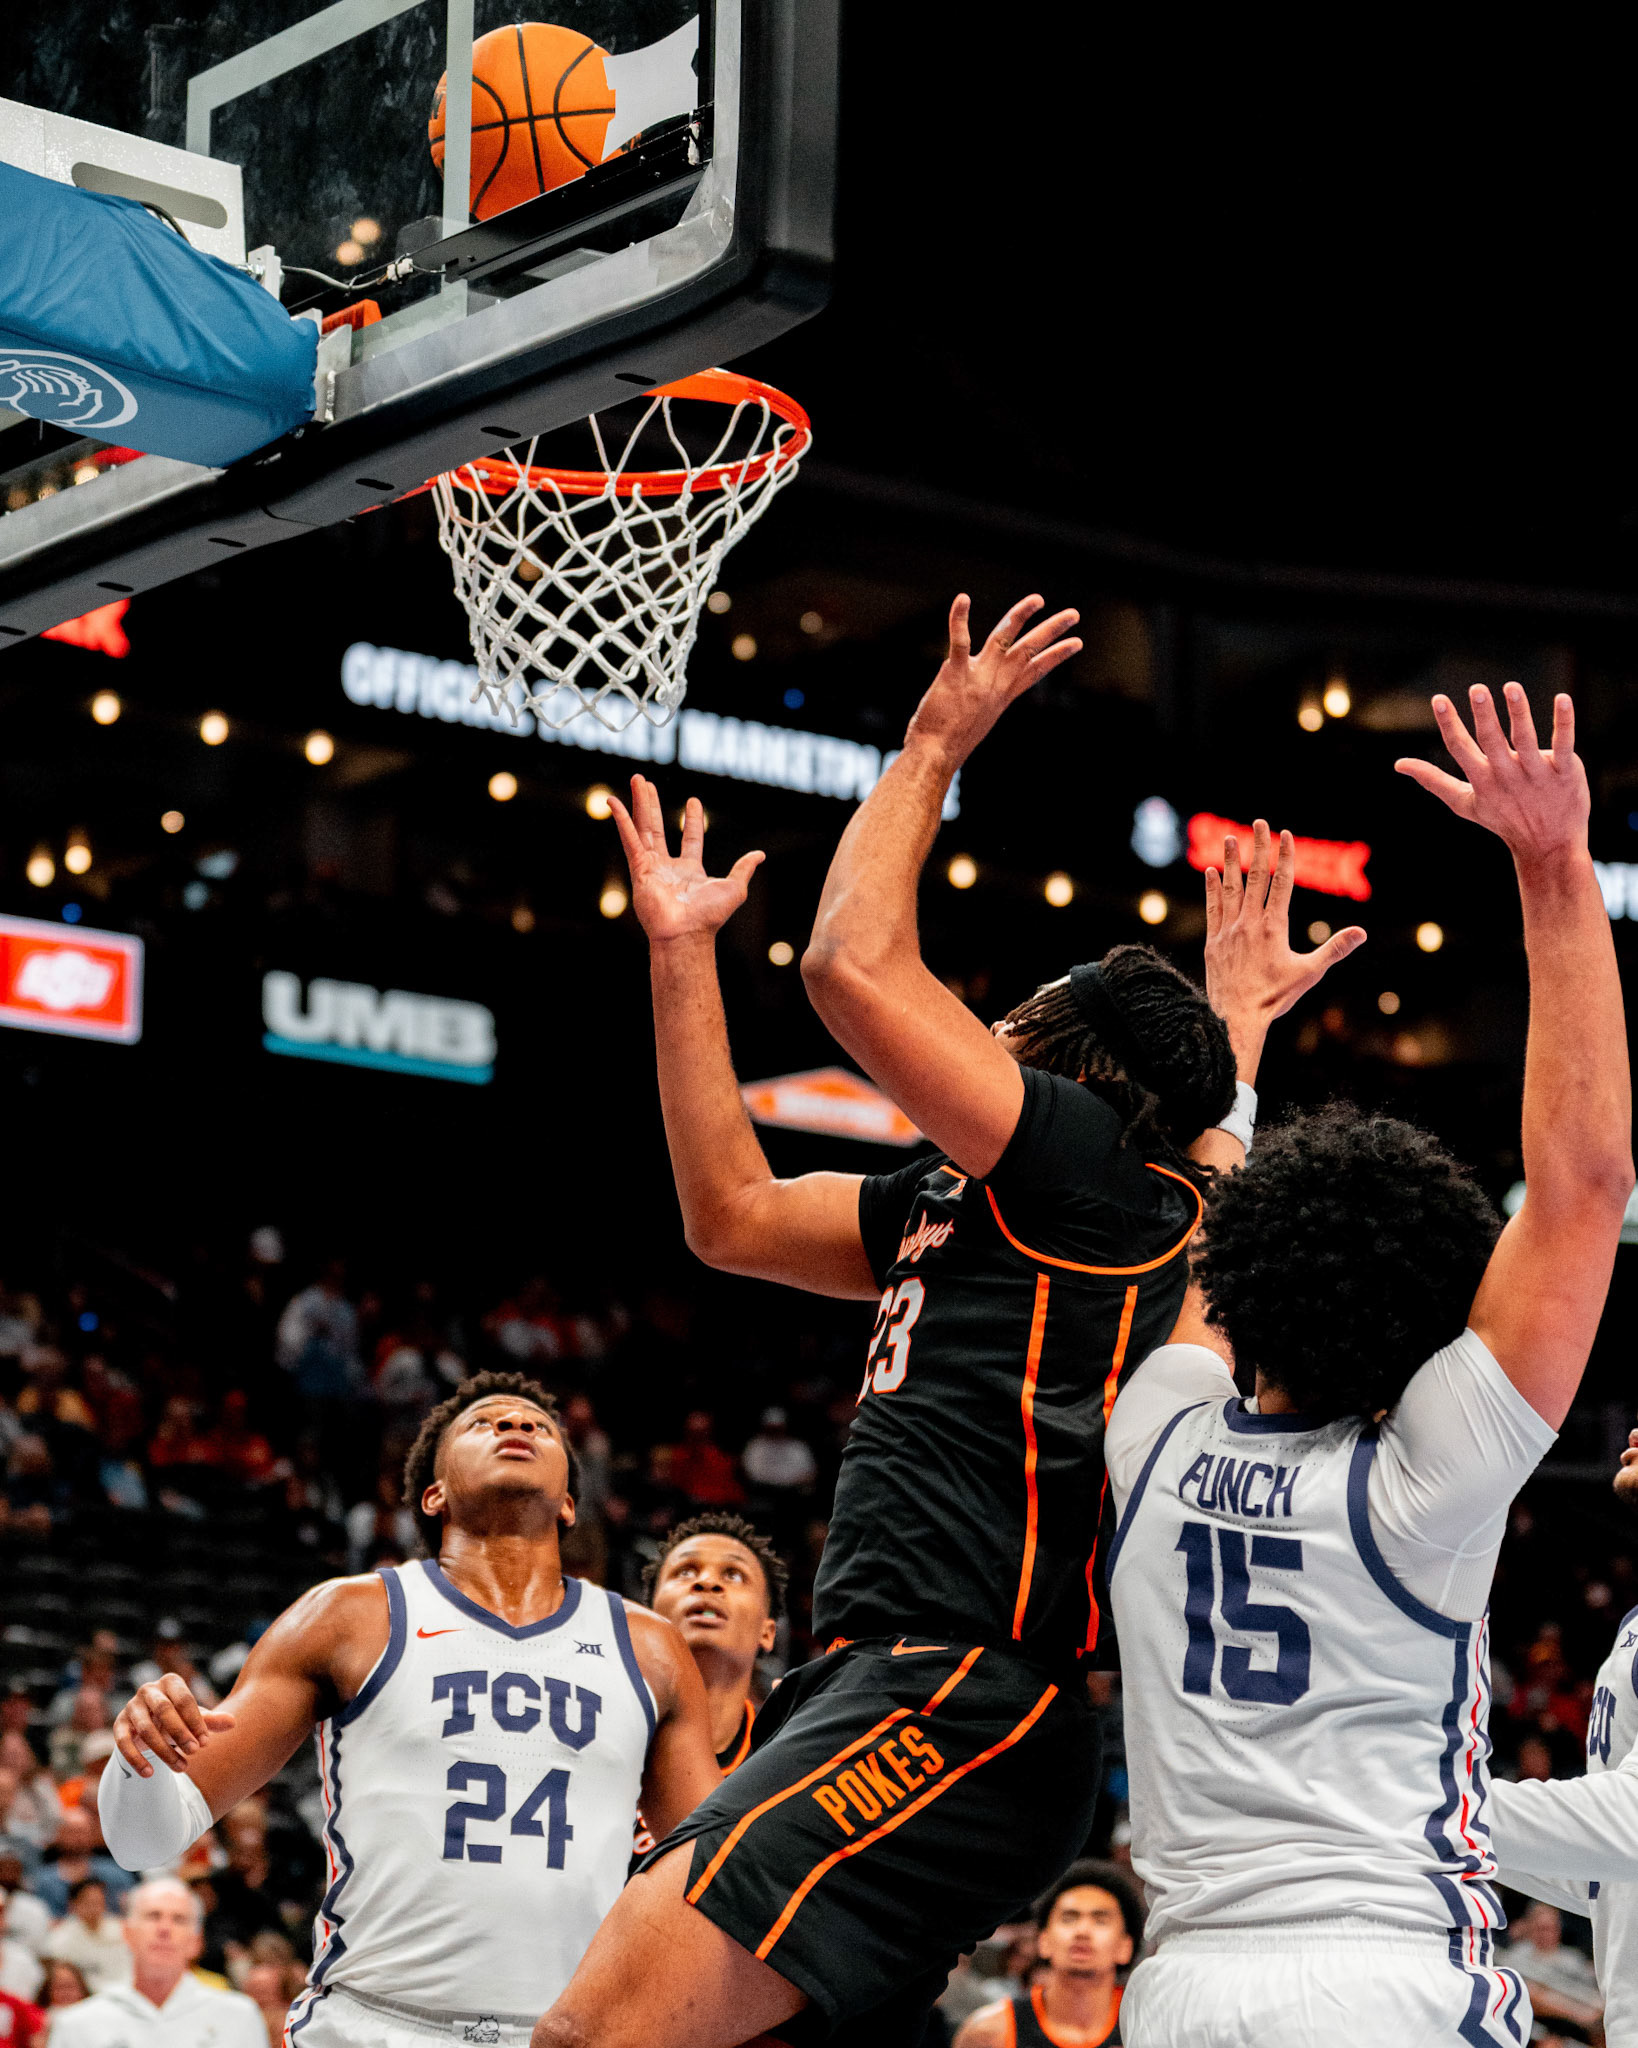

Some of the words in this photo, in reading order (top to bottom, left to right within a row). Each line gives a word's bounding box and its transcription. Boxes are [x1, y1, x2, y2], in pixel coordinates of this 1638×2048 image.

[341, 642, 536, 737] OFFICIAL
[262, 969, 497, 1068] UMB
[856, 1276, 926, 1408] 23
[1178, 1452, 1301, 1518] FUNCH
[1175, 1521, 1311, 1706] 15
[431, 1670, 602, 1752] TCU
[443, 1760, 574, 1870] 24
[811, 1725, 945, 1836] POKES
